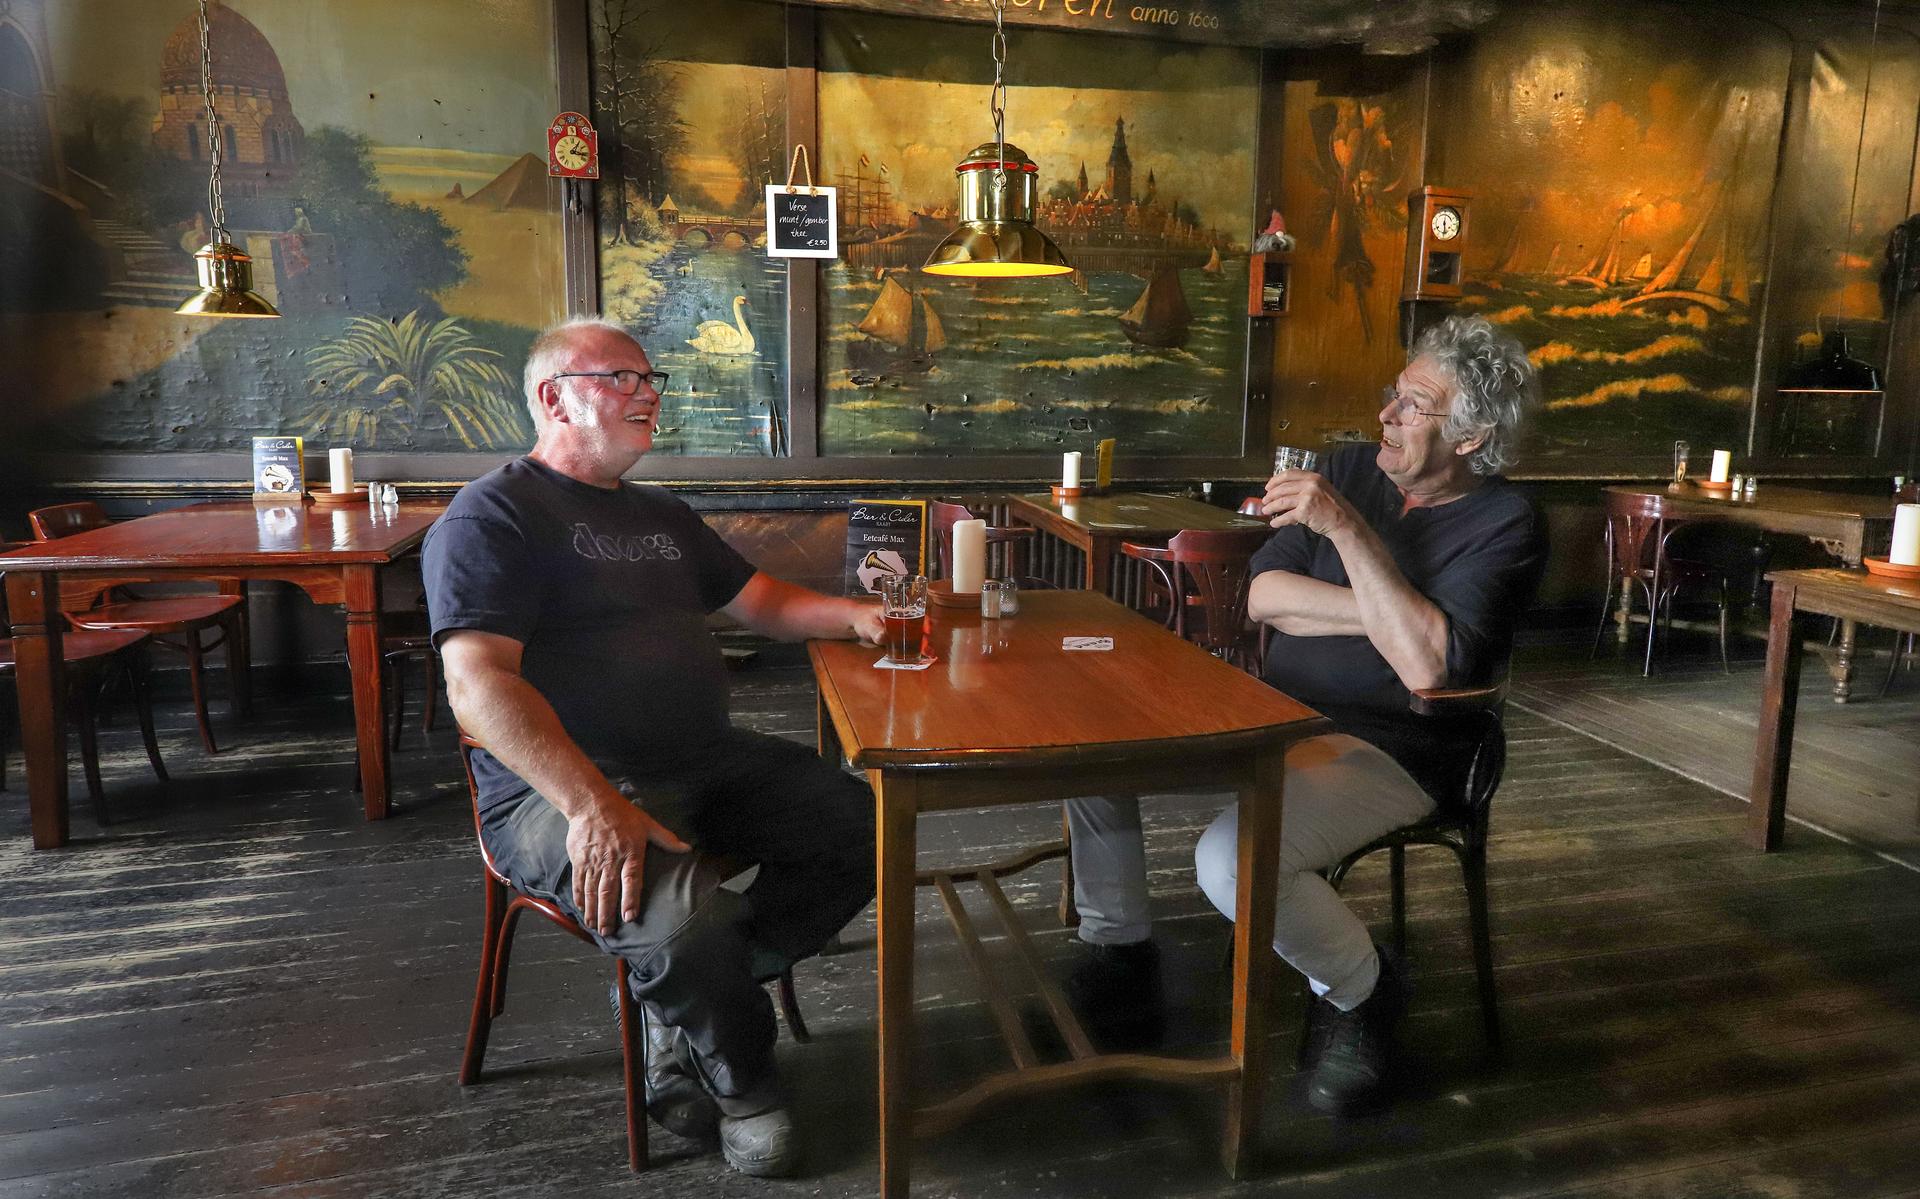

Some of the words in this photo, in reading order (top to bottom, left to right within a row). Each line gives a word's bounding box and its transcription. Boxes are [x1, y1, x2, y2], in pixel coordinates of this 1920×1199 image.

[1131, 6, 1179, 25] anno
[1188, 11, 1219, 29] 1600
[789, 199, 808, 212] Verse
[851, 507, 878, 521] Bier
[879, 512, 888, 521] &
[888, 508, 918, 523] Cider
[863, 533, 888, 543] Eetcafé
[889, 535, 905, 543] Max
